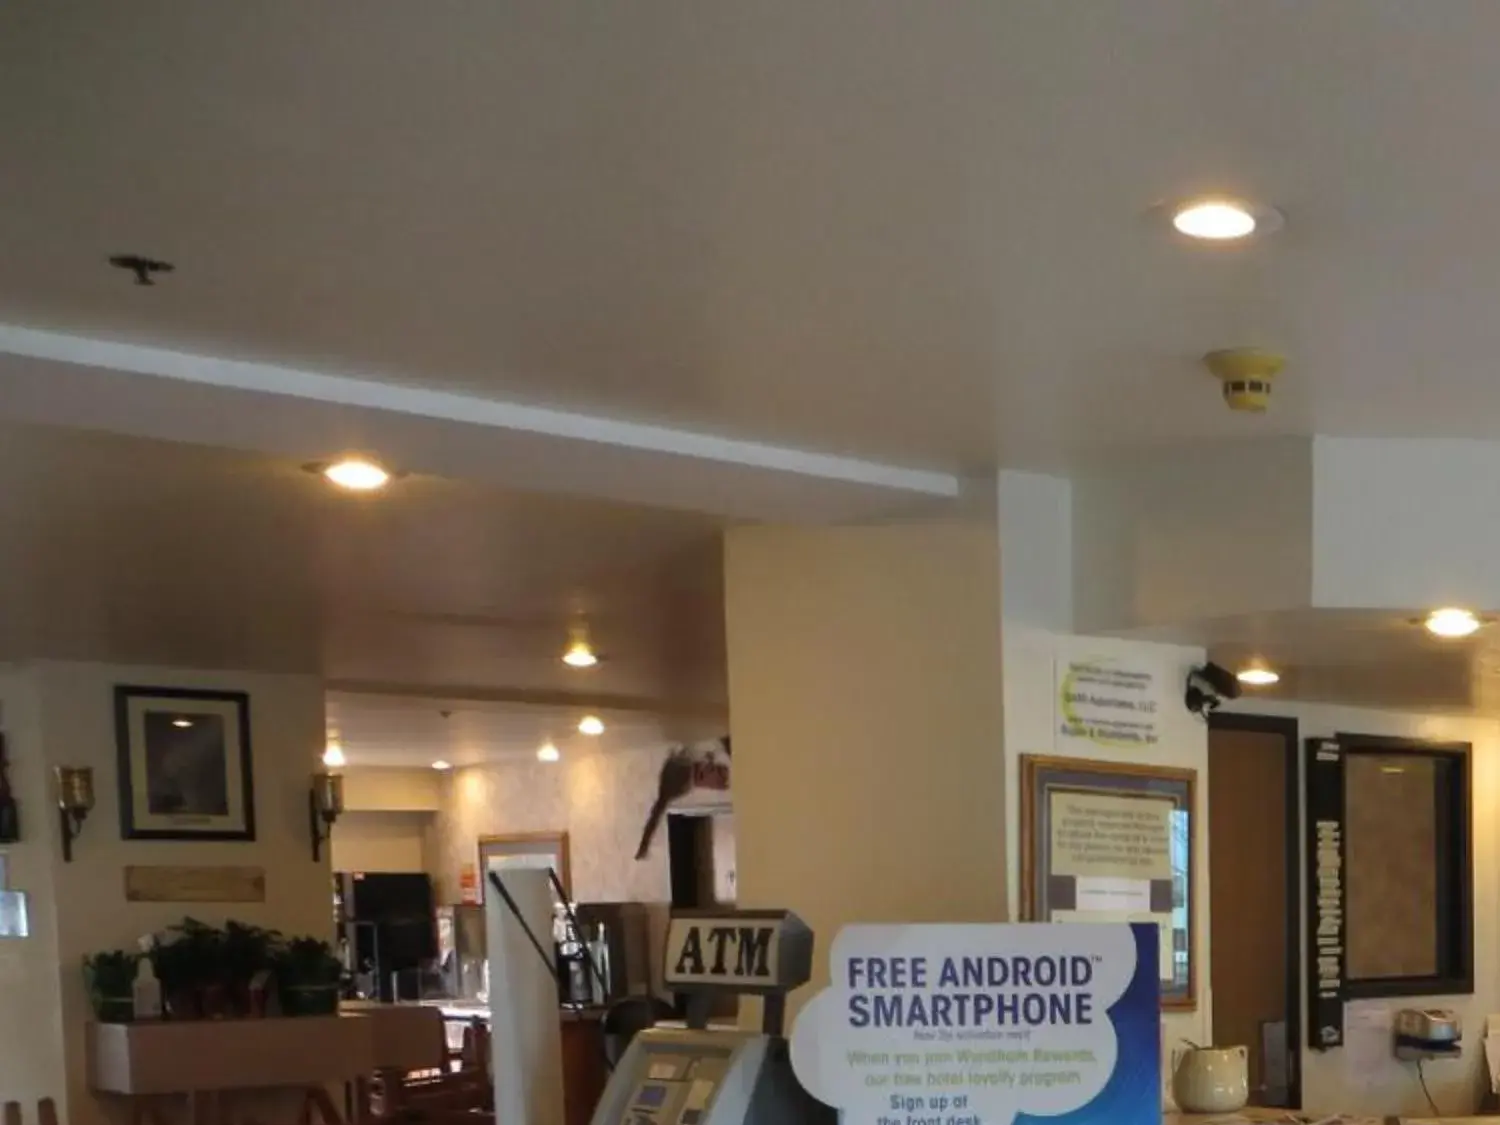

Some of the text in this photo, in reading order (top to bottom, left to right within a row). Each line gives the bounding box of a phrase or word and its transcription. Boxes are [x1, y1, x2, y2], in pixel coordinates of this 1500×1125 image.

[674, 926, 775, 977] ATM
[848, 956, 928, 989] FREE
[847, 992, 1093, 1028] SMARTPHONE
[847, 1050, 889, 1066] When
[893, 1053, 920, 1067] you
[925, 1051, 951, 1067] join
[955, 1048, 1029, 1067] Wyndham
[864, 1076, 888, 1087] our
[894, 1072, 922, 1087] free
[927, 1072, 964, 1087] hotel
[968, 1071, 1017, 1090] loyalty
[889, 1095, 969, 1113] Sign up at
